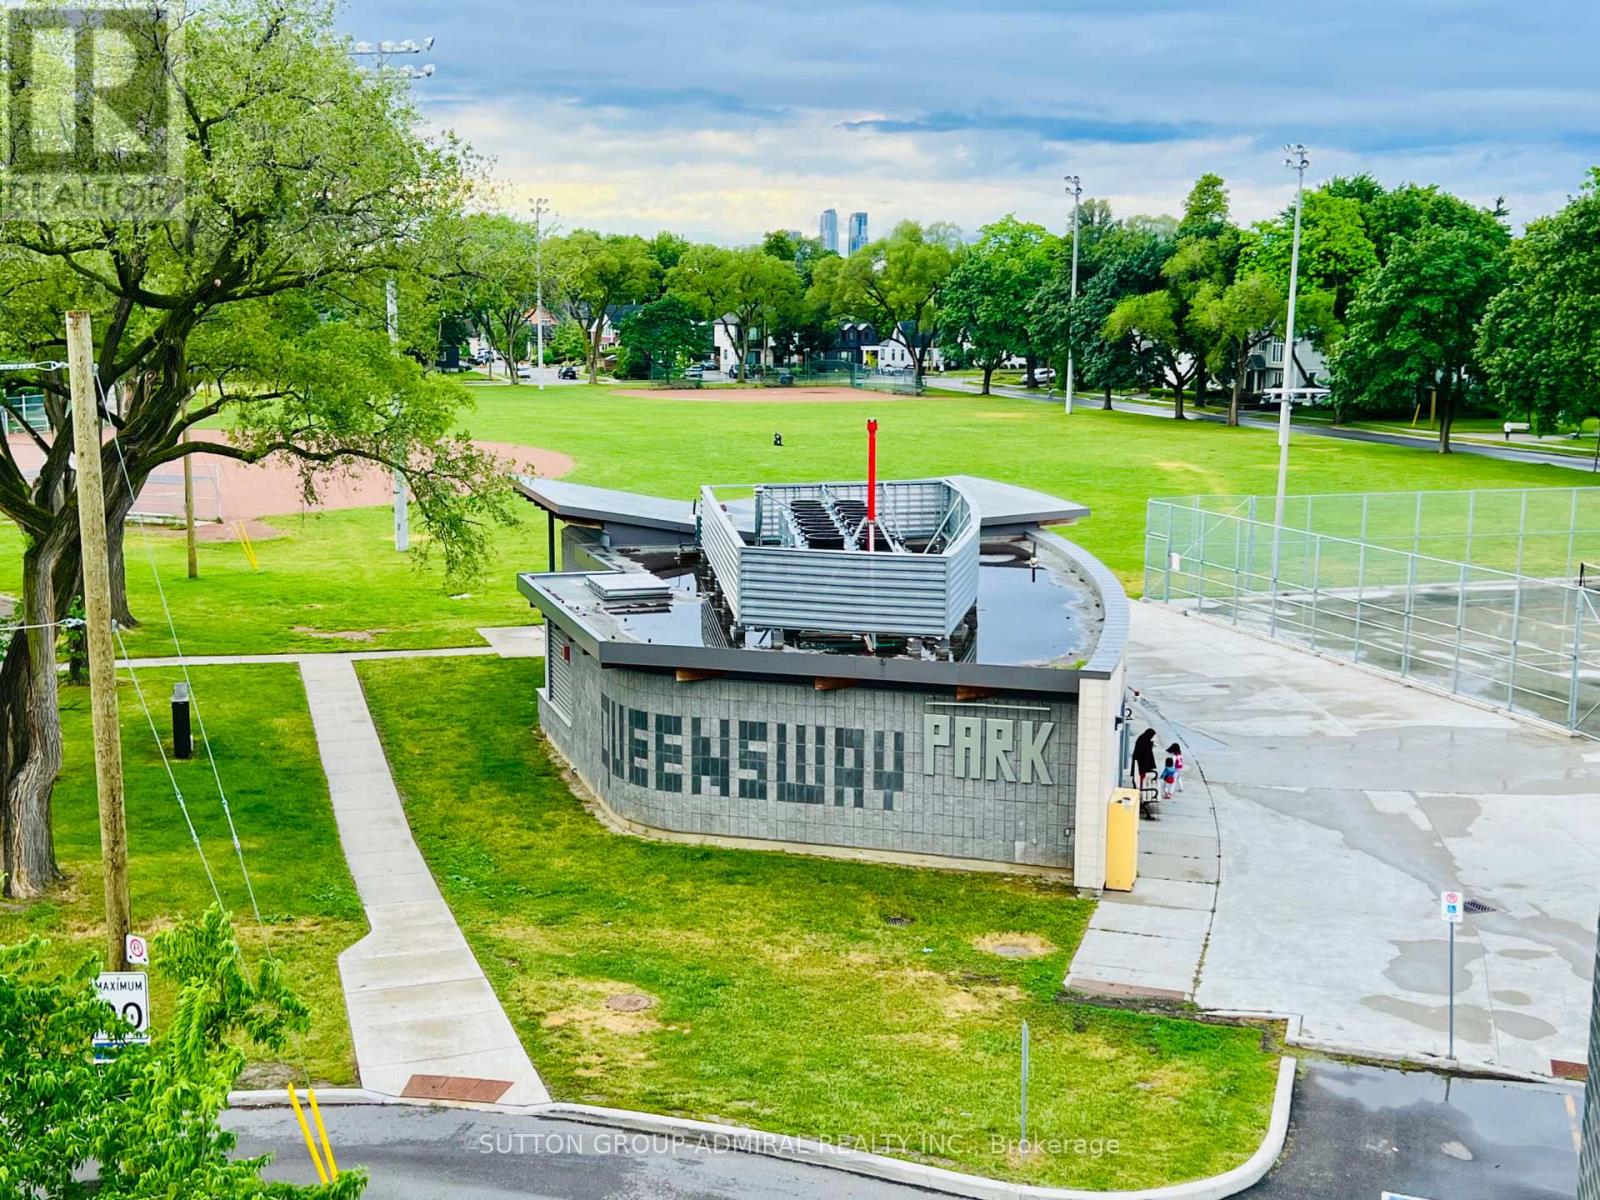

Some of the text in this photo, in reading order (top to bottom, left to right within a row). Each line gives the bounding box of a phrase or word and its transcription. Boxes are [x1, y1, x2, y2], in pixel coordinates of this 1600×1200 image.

[601, 691, 1054, 810] QUEENSWAY PARK
[106, 1002, 142, 1029] 0
